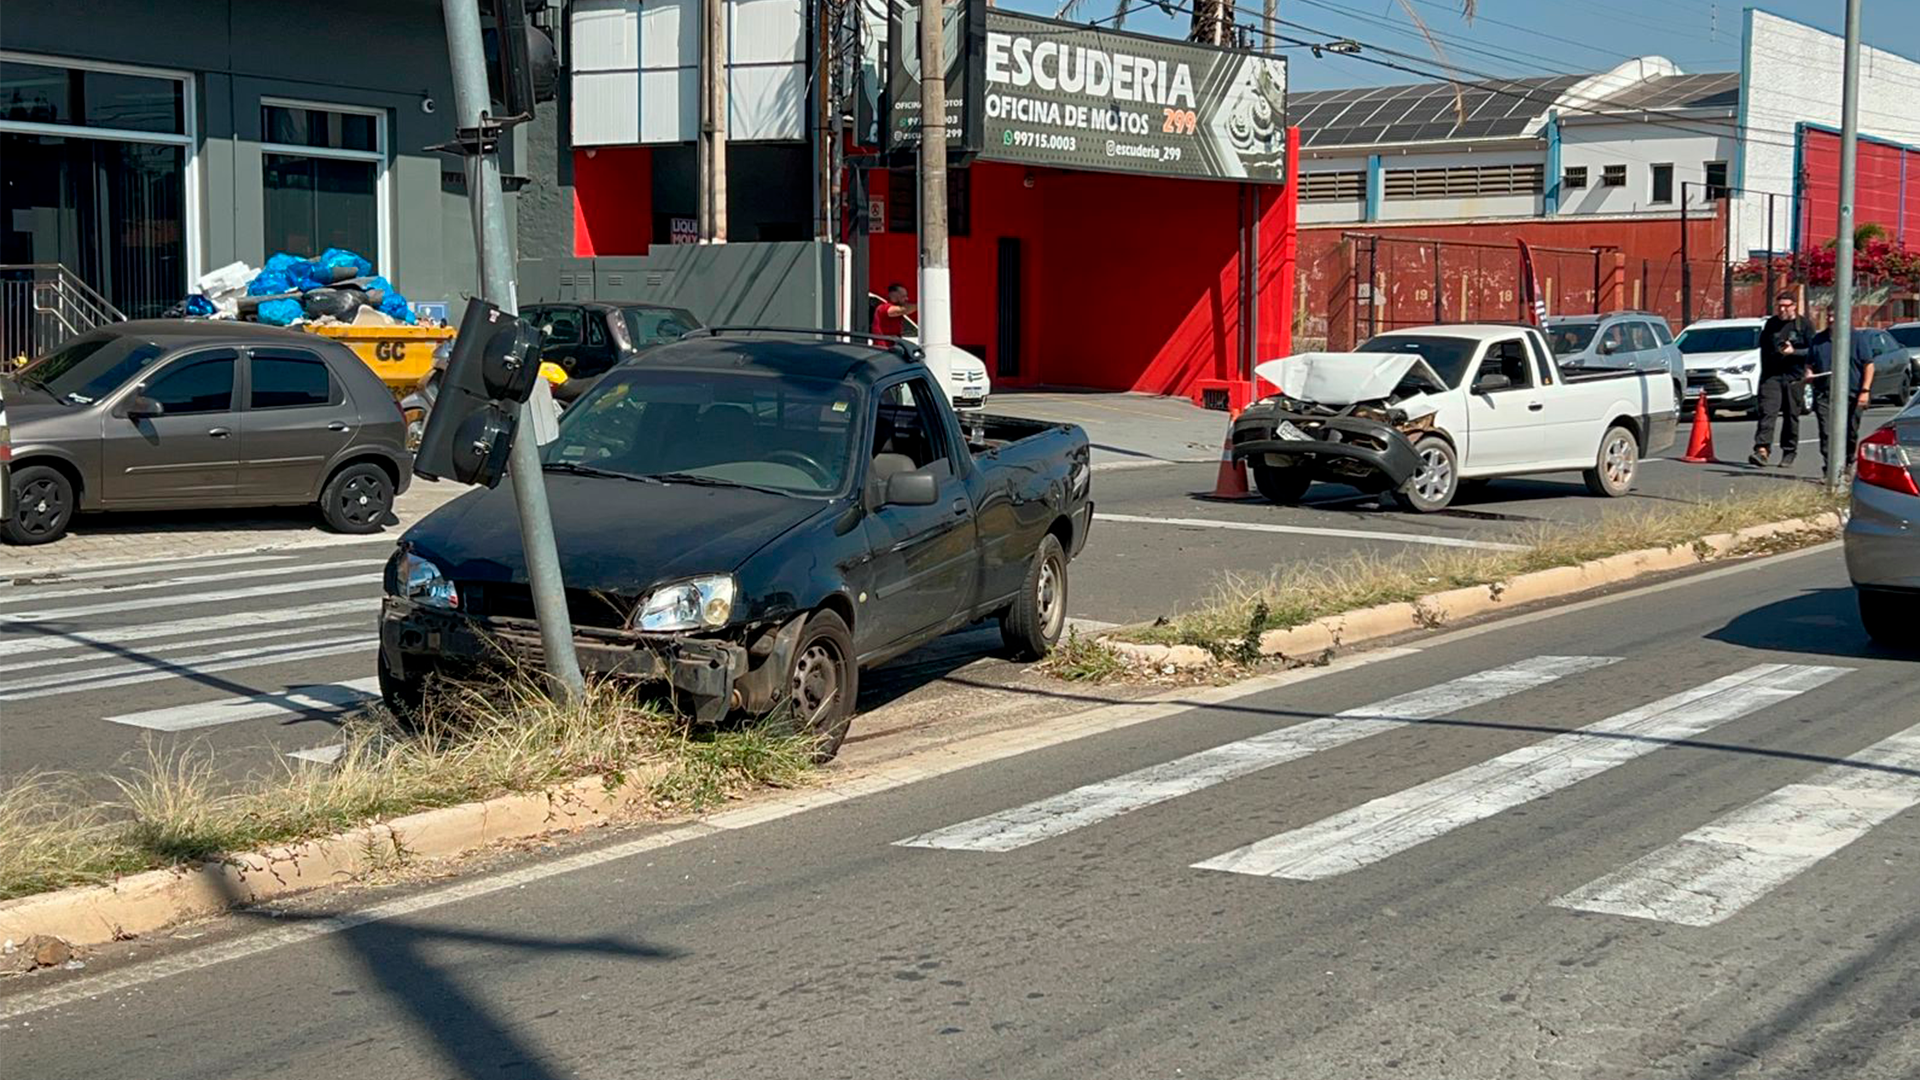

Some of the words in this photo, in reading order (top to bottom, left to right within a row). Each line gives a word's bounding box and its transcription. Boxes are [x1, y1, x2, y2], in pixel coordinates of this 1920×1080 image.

[986, 32, 1196, 108] ESCUDERIA
[985, 94, 1061, 125] OFICINA
[1064, 104, 1088, 128] DE
[1091, 108, 1149, 134] MOTOS
[1162, 108, 1196, 135] 299
[1013, 131, 1076, 151] 99715.0003
[1415, 289, 1428, 301] 19
[1499, 290, 1512, 302] 18
[376, 341, 406, 362] GC
